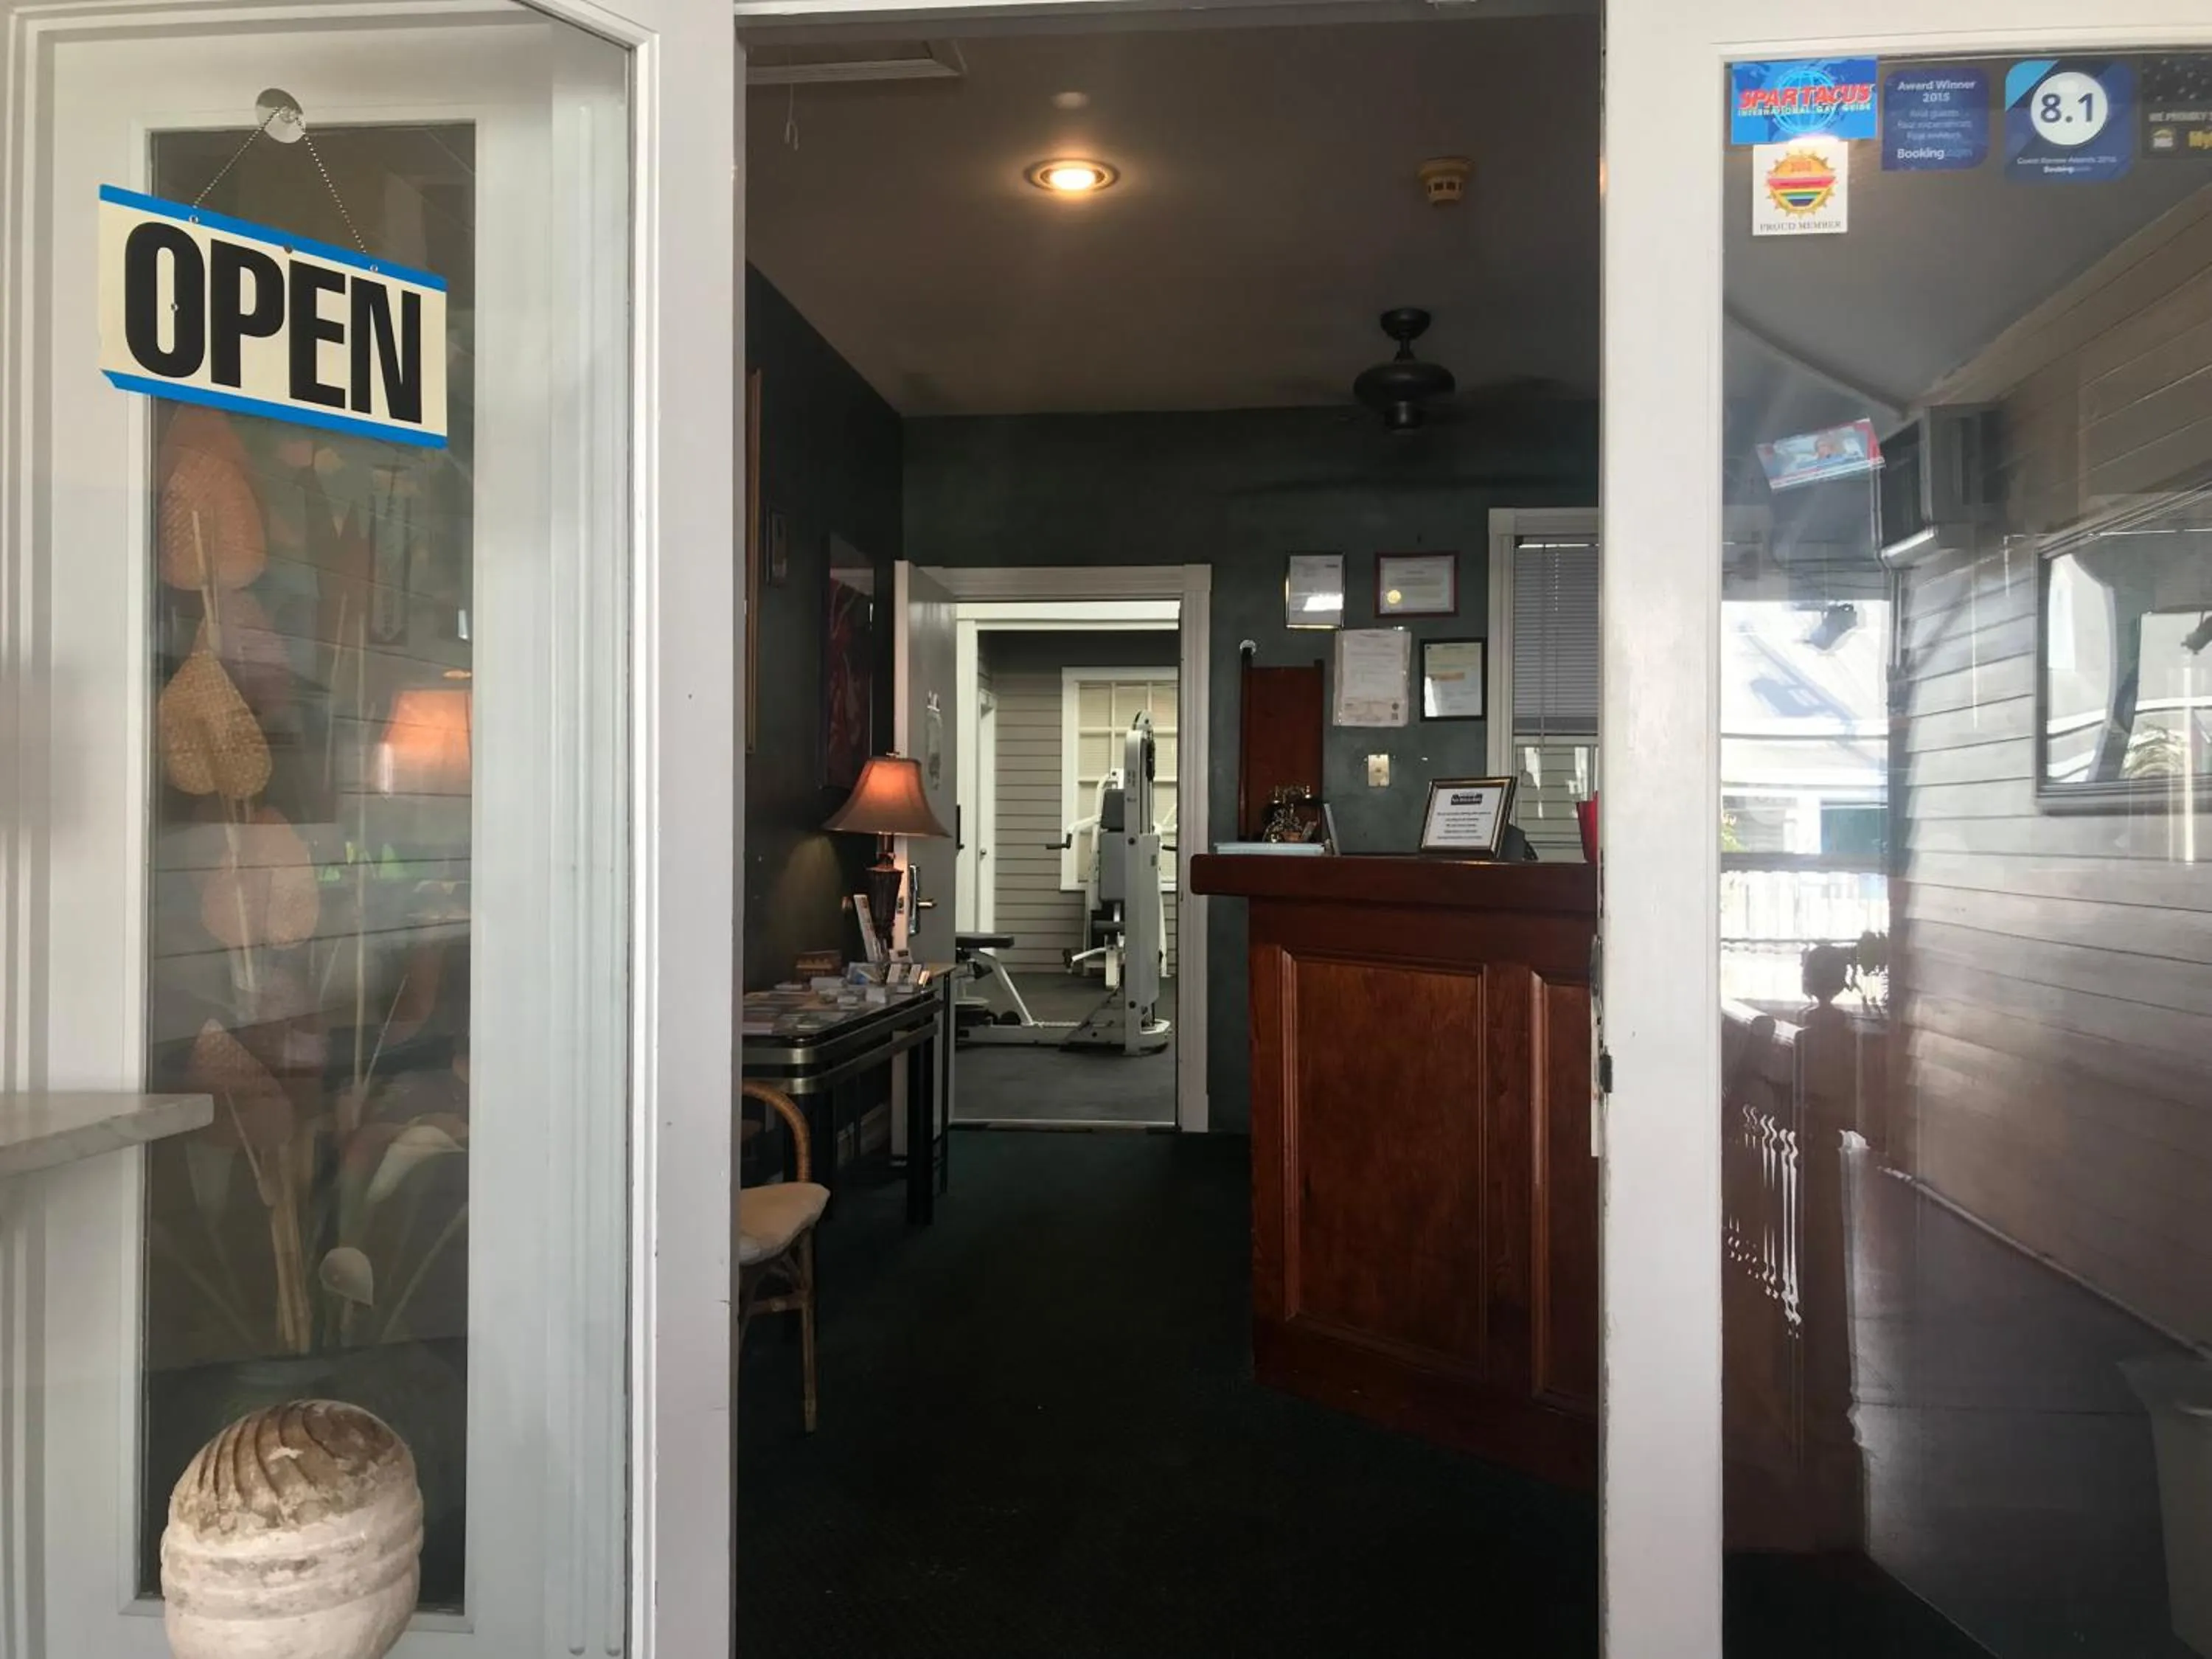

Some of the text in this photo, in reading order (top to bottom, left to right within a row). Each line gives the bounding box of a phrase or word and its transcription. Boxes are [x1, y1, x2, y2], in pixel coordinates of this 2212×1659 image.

[1897, 80, 1976, 91] Award Winner
[1739, 83, 1875, 110] SPARTACUS
[1922, 92, 1950, 102] 2015
[1738, 105, 1809, 116] INTERNATIONAL
[2040, 93, 2093, 123] 8.1
[1760, 220, 1841, 232] PROUD MEMBER
[125, 221, 422, 424] OPEN
